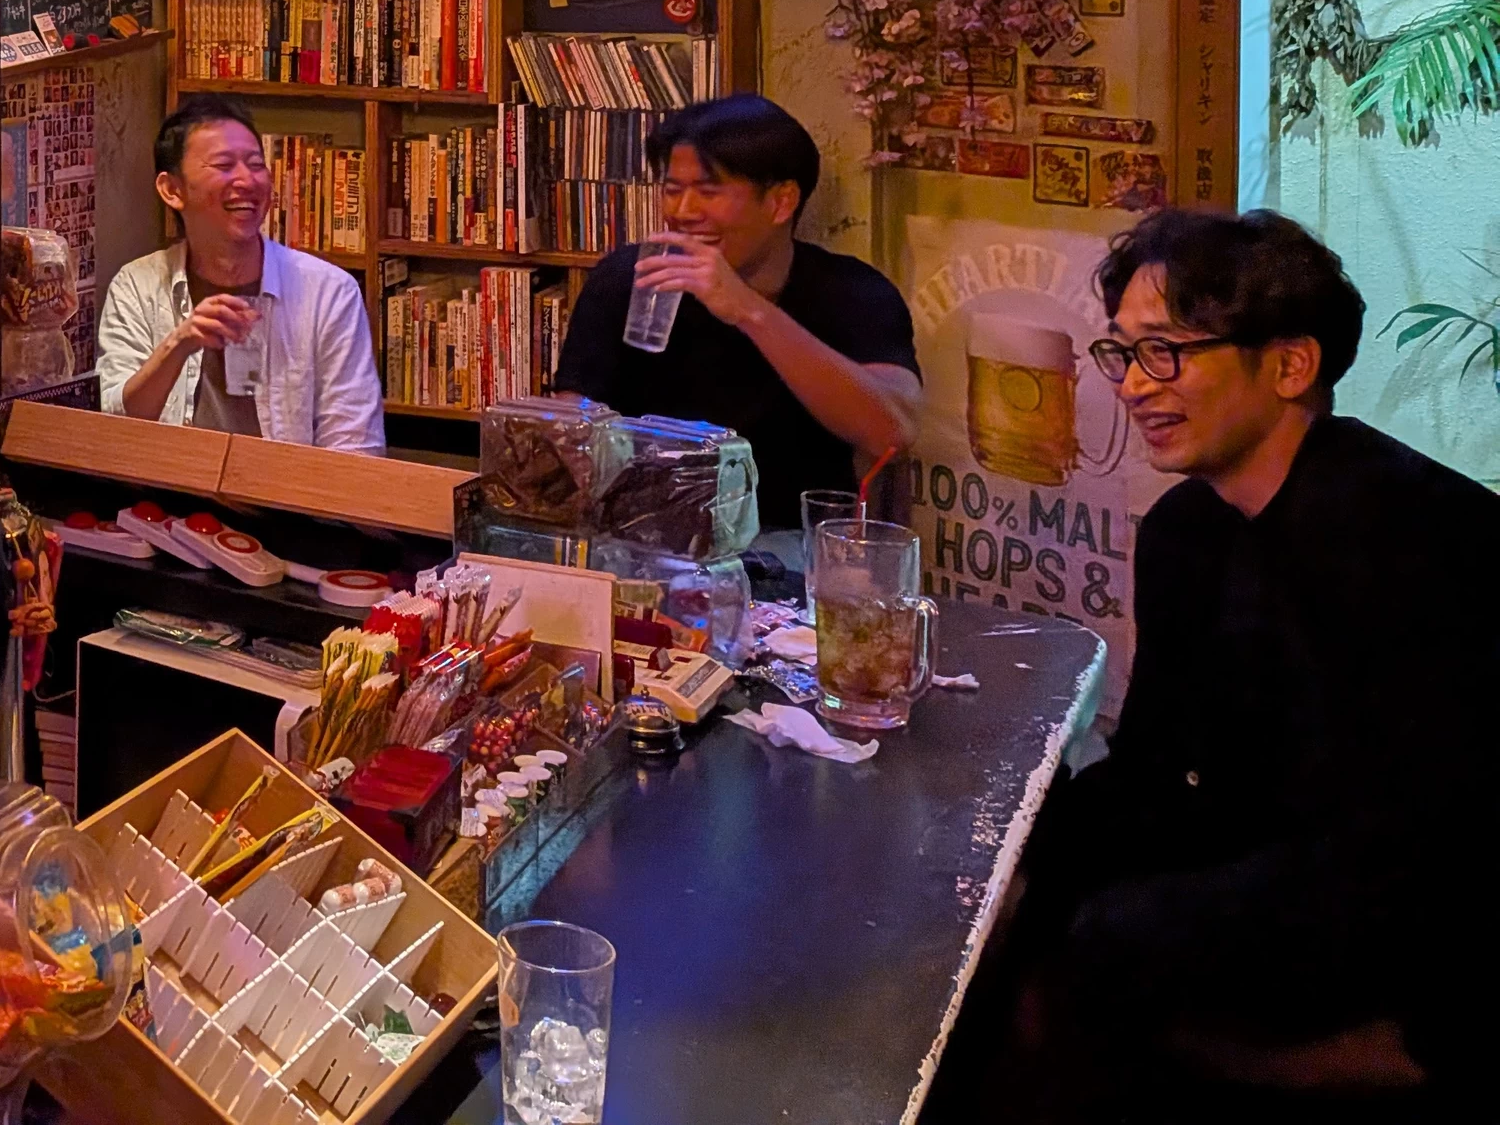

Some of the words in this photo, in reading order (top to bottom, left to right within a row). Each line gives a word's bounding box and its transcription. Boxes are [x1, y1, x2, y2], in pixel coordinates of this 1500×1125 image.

[913, 242, 1108, 332] HEARTLA
[1028, 488, 1140, 561] MAL
[935, 521, 1067, 600] HOPS
[1082, 569, 1124, 620] &
